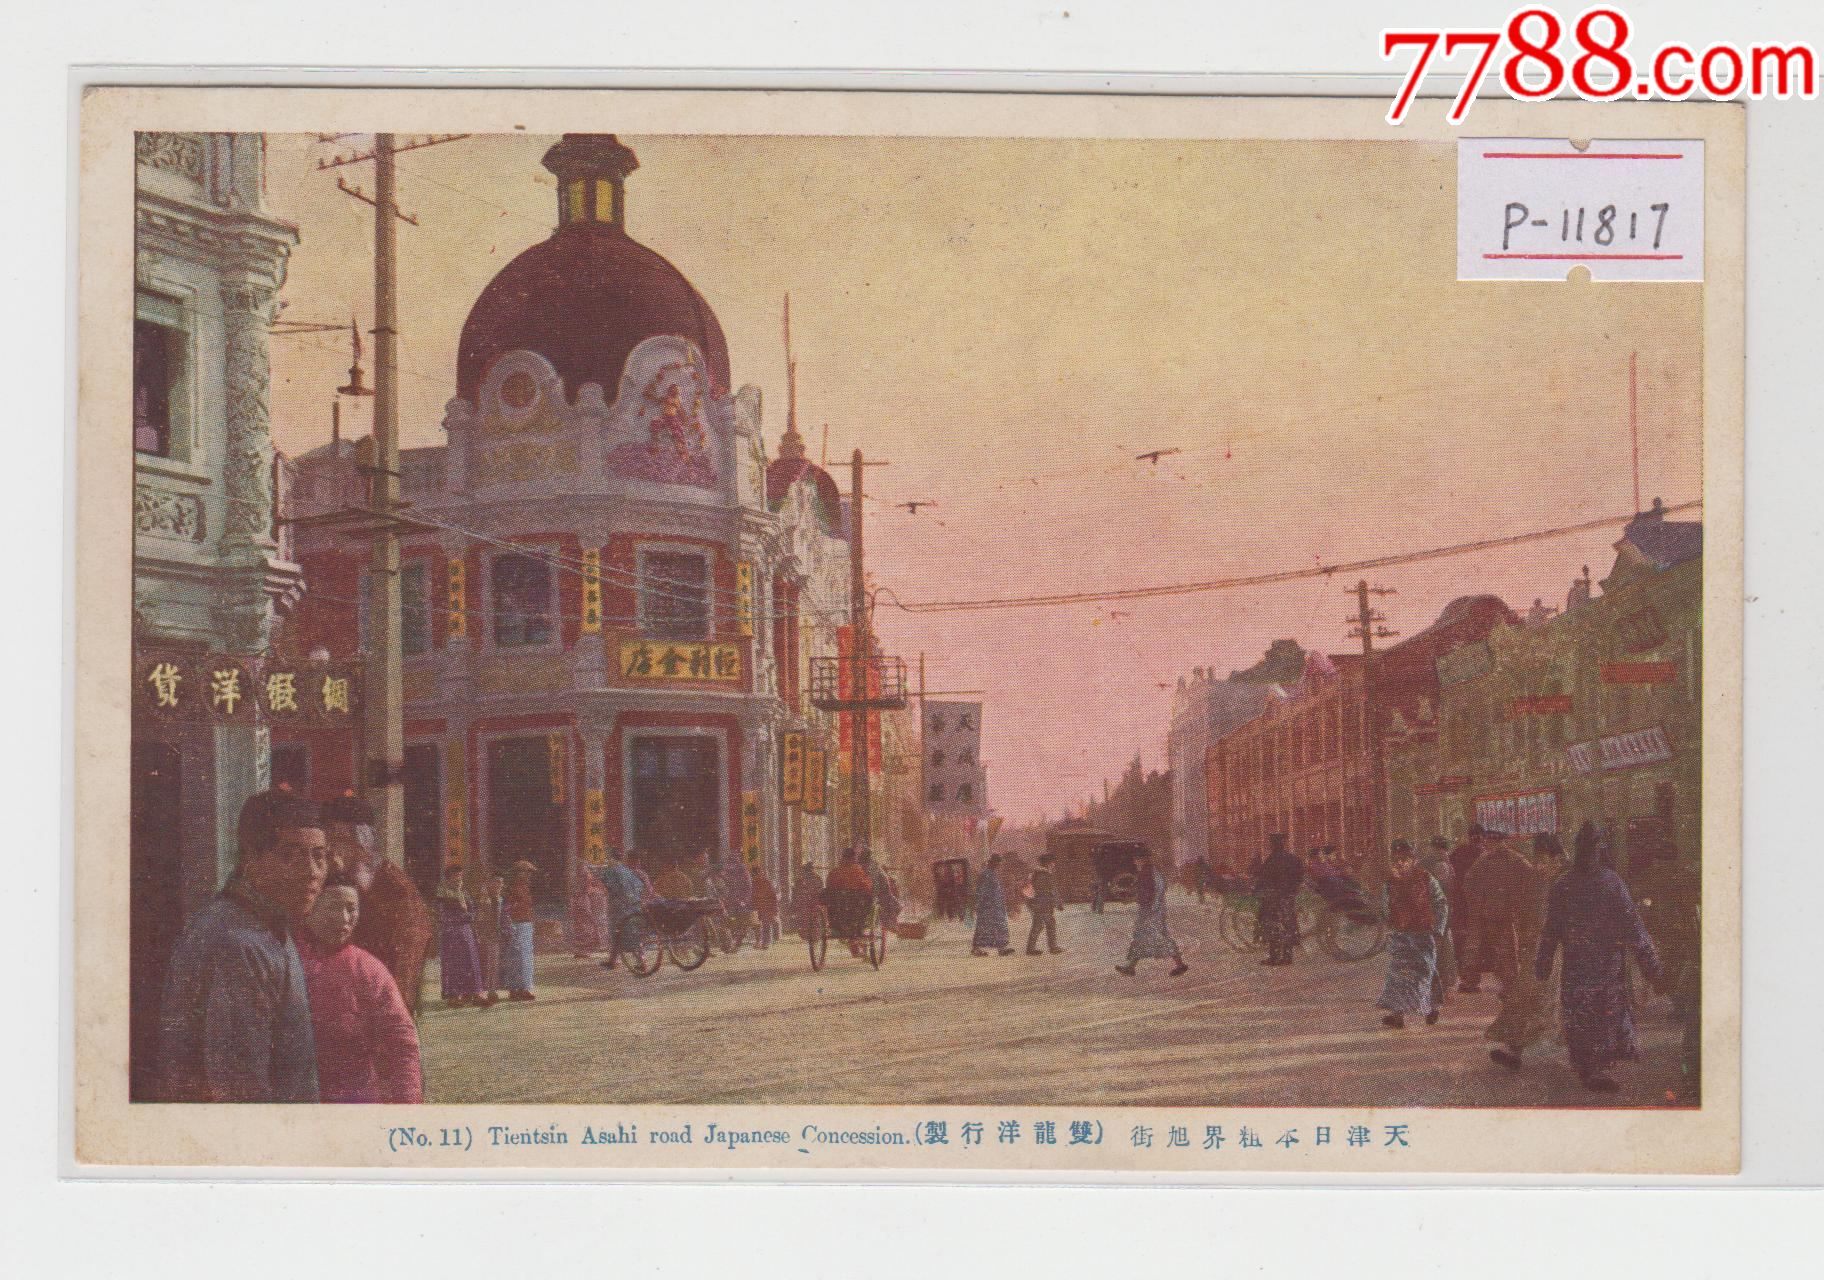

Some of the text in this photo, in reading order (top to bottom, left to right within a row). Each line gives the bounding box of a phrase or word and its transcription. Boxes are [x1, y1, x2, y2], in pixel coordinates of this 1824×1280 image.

[1502, 202, 1670, 251] P-11817
[440, 1127, 473, 1152] 11)
[487, 1124, 569, 1149] Tientsin
[580, 1124, 638, 1148] Asahi
[649, 1122, 693, 1146] road
[703, 1122, 790, 1152] Japanese
[800, 1124, 912, 1150] Concession.
